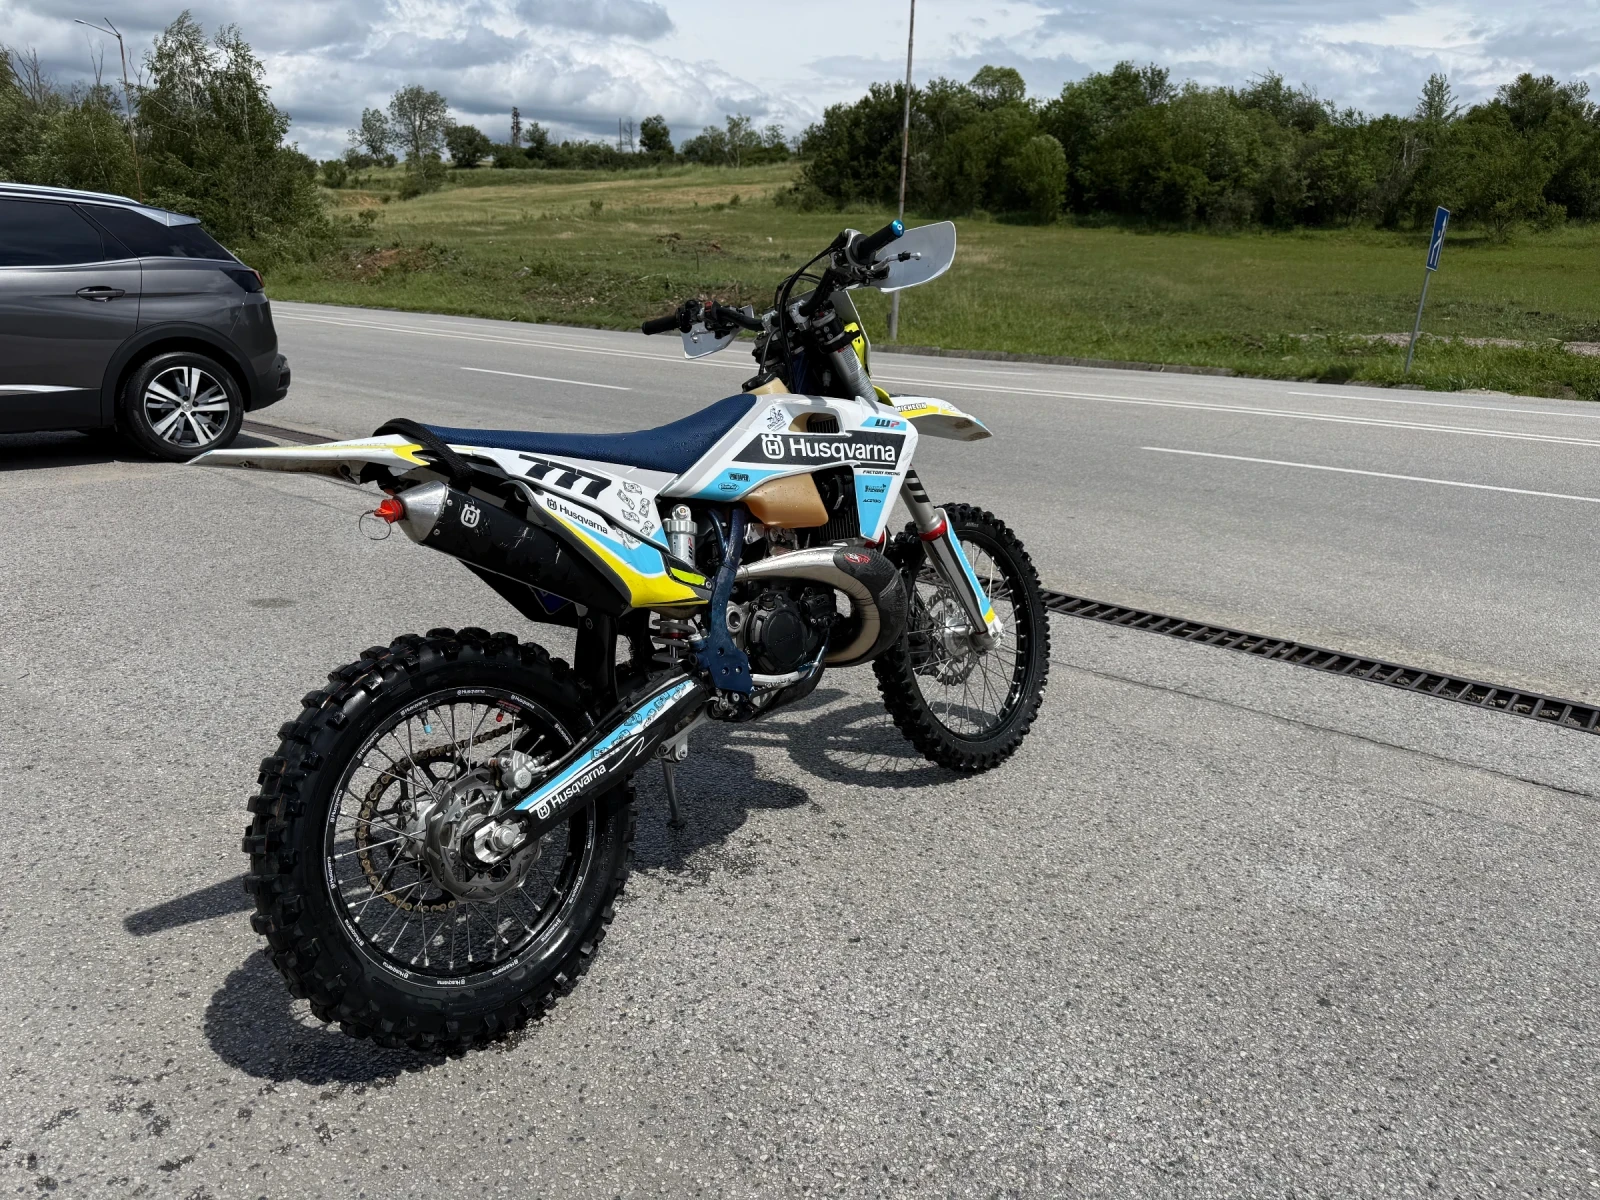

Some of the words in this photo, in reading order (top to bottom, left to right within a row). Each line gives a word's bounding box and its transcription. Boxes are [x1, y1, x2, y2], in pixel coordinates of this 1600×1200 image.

[875, 418, 900, 428] WP
[788, 438, 896, 461] Husqvarna
[518, 453, 612, 500] 777
[559, 505, 608, 534] Husqvarna
[550, 764, 606, 809] Husqvarna
